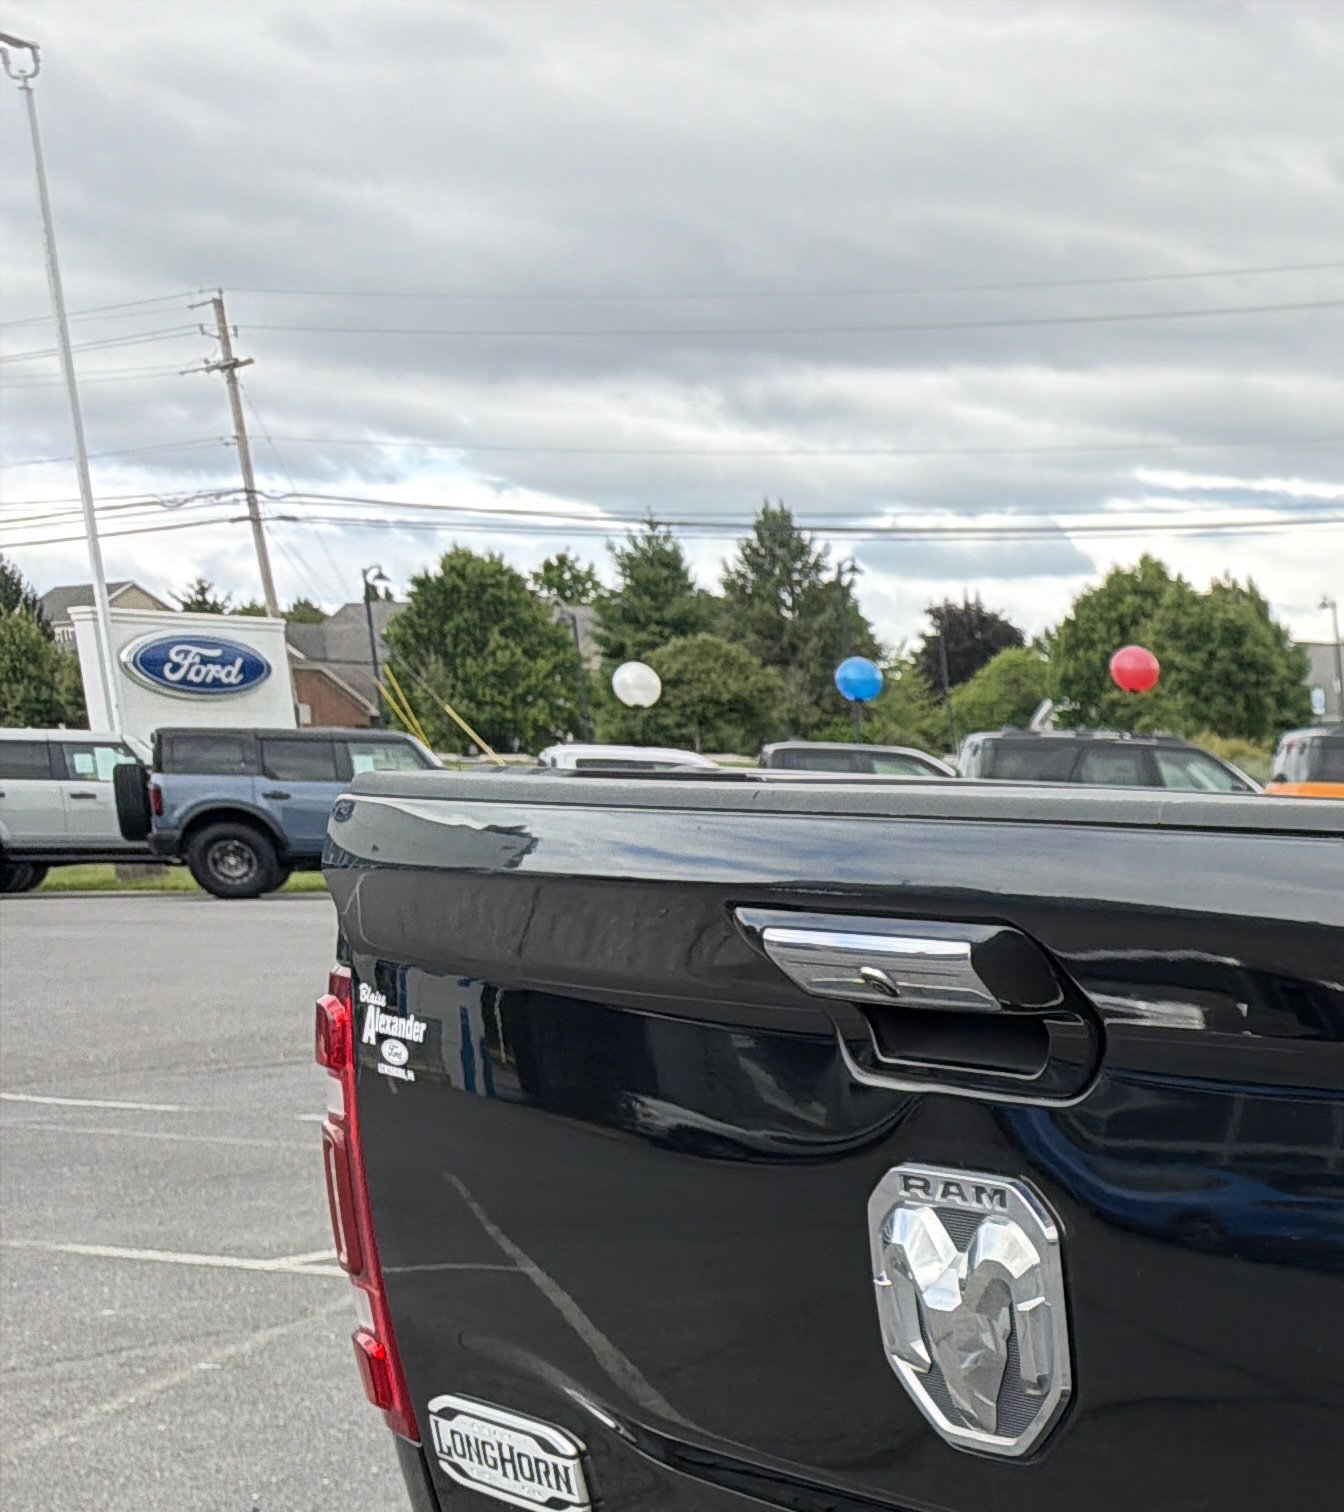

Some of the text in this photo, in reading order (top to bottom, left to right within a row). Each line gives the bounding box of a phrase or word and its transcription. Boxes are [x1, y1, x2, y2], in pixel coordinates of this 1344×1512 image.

[163, 644, 244, 685] Ford
[362, 1004, 426, 1046] Alexander
[902, 1175, 1008, 1209] RAM
[432, 1418, 576, 1497] LONGHORN
